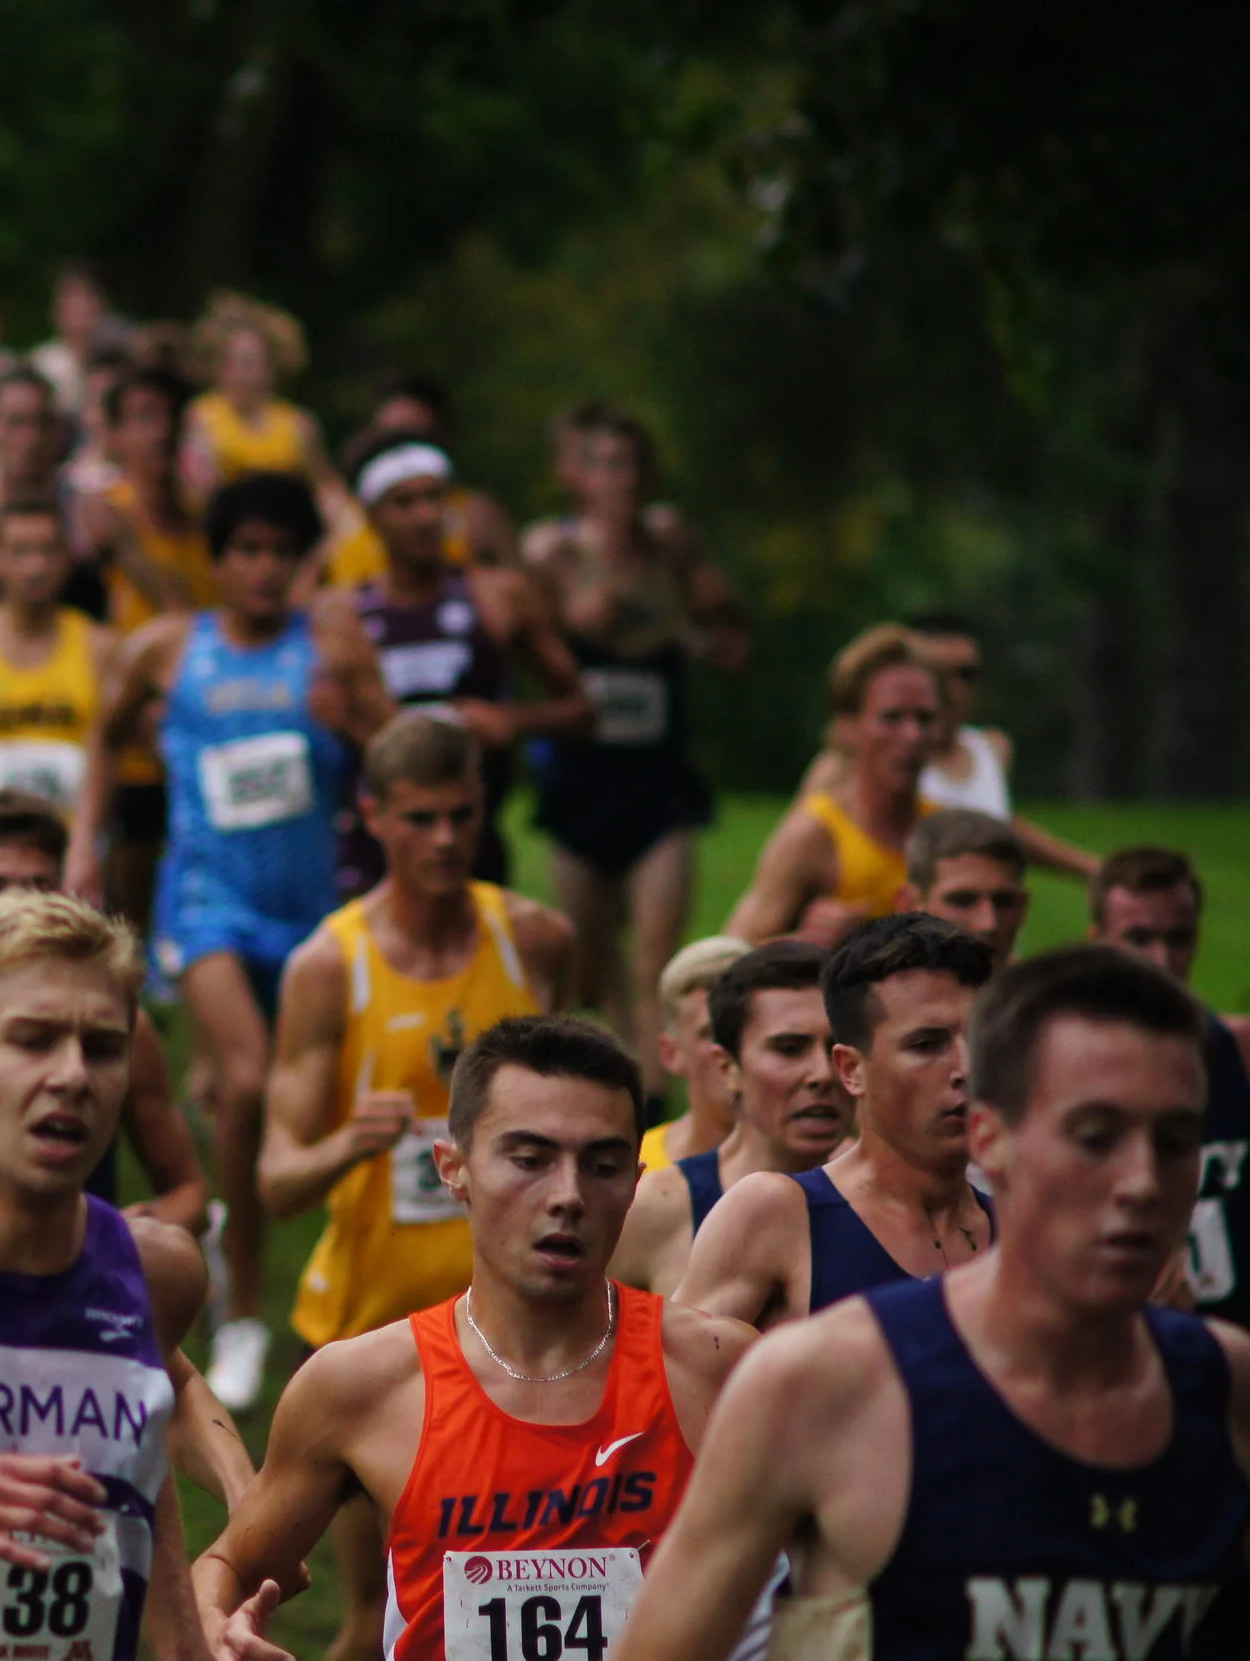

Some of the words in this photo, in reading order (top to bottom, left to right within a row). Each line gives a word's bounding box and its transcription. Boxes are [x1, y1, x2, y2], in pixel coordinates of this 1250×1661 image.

[437, 1471, 657, 1538] ILLINOIS
[497, 1557, 607, 1580] BEYNON
[515, 1584, 542, 1592] Tarkett
[544, 1583, 570, 1593] Sports
[571, 1582, 607, 1592] Company
[478, 1595, 608, 1661] 164
